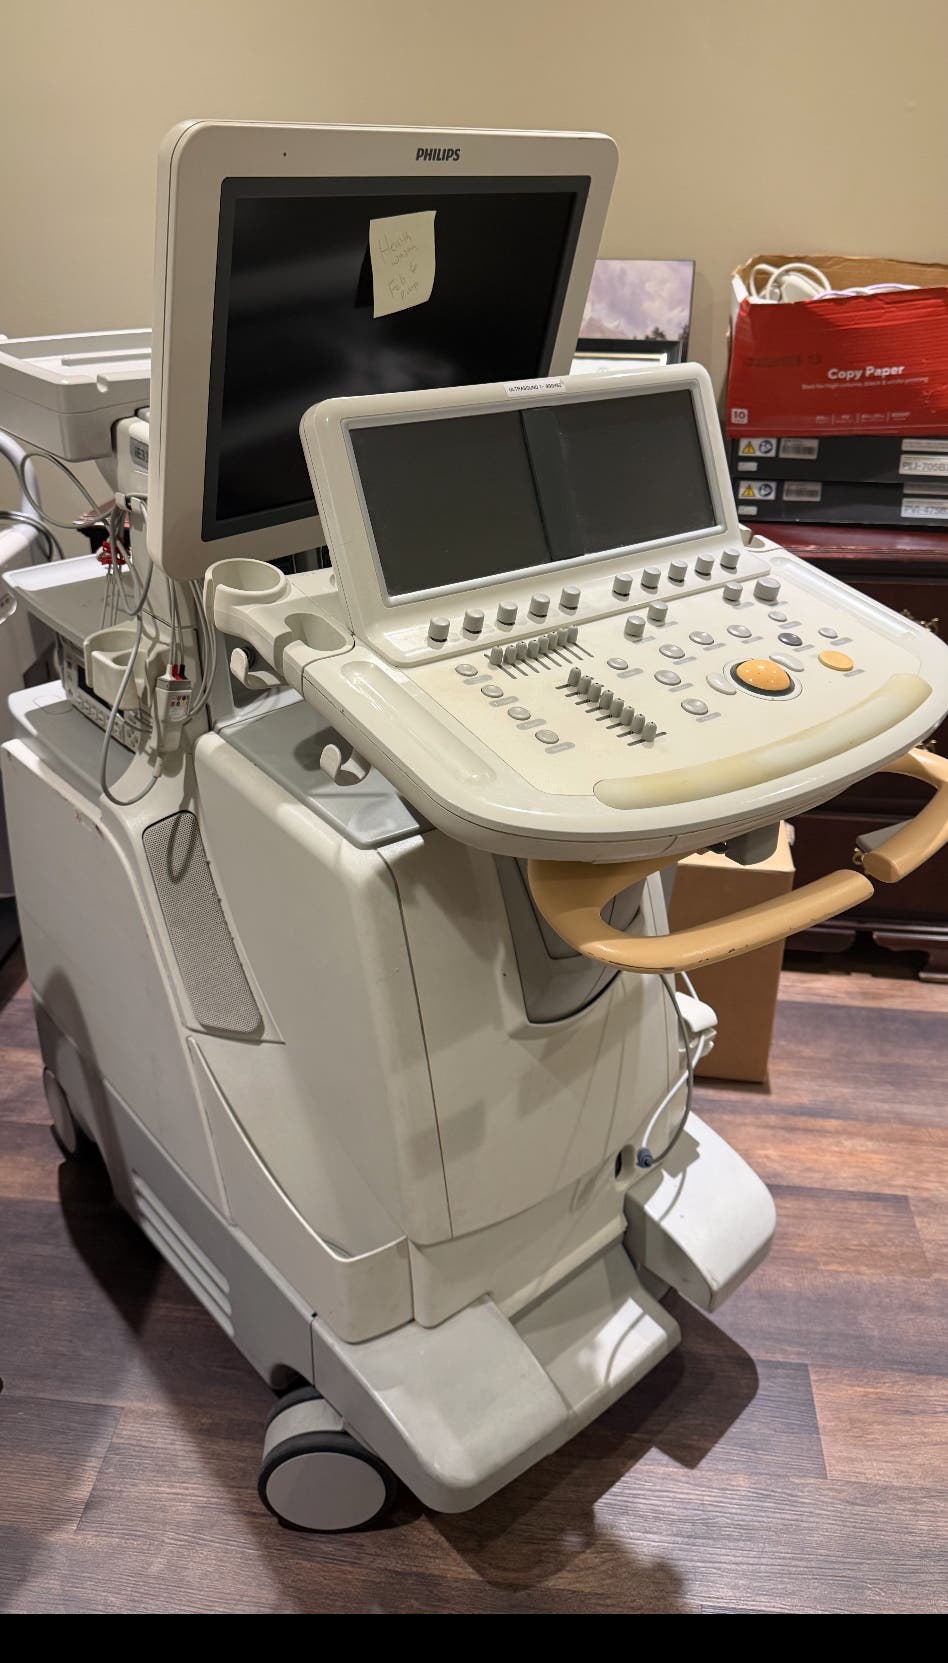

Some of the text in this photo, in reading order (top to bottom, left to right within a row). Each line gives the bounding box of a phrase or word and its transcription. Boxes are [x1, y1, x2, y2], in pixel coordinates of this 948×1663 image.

[416, 148, 461, 161] PHILIPS
[827, 366, 905, 380] Copy Paper
[508, 384, 539, 392] ULTRASOUND
[734, 411, 746, 419] 10
